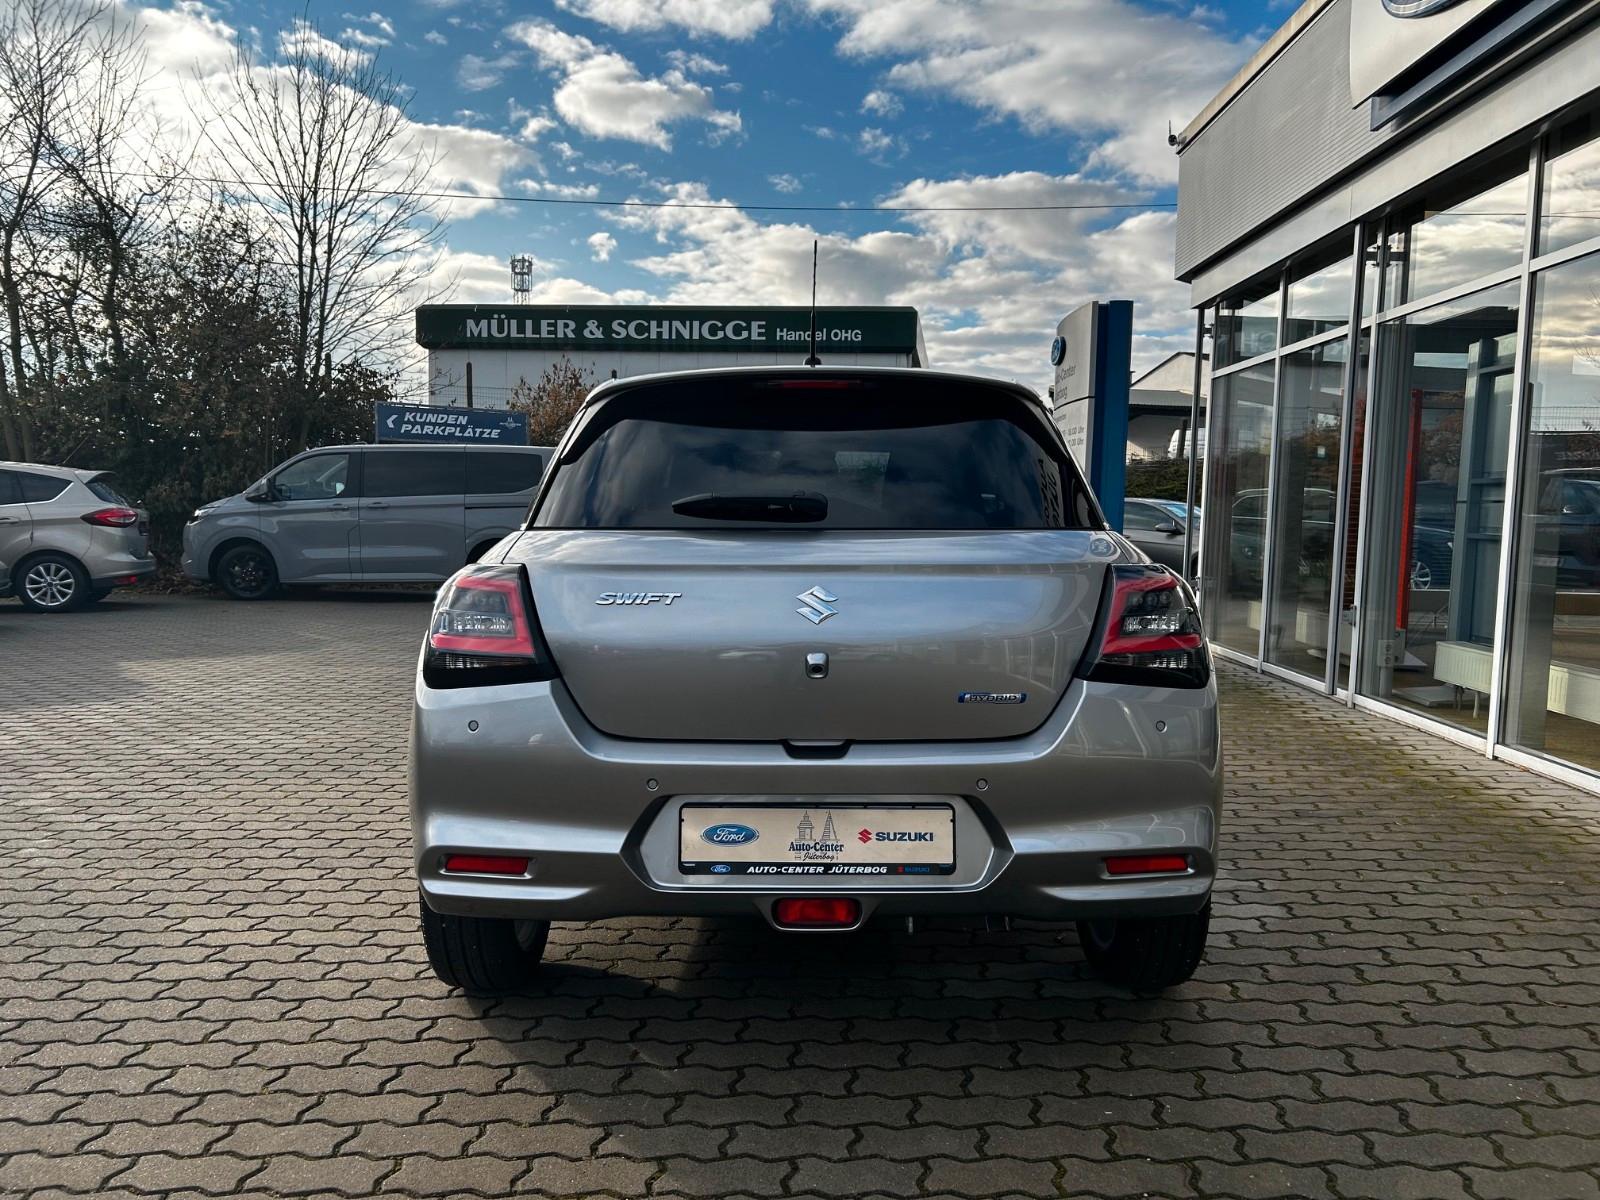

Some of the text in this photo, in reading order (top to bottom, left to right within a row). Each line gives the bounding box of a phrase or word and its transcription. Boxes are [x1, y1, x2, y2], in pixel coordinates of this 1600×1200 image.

[466, 314, 577, 338] MÜLLER
[583, 319, 605, 339] &
[611, 319, 767, 340] SCHNIGGE
[831, 329, 862, 341] OHG
[404, 412, 468, 425] KUNDEN
[400, 424, 501, 438] PARKPLÄTZE
[594, 592, 682, 606] SWIFT
[969, 695, 1018, 703] HYBRID
[713, 827, 745, 842] Ford
[875, 831, 934, 842] SUZUKI
[788, 841, 844, 852] Auto-Center
[802, 852, 835, 862] Jüterbog
[747, 864, 887, 874] AUTO-CENTER JÜTERBOG
